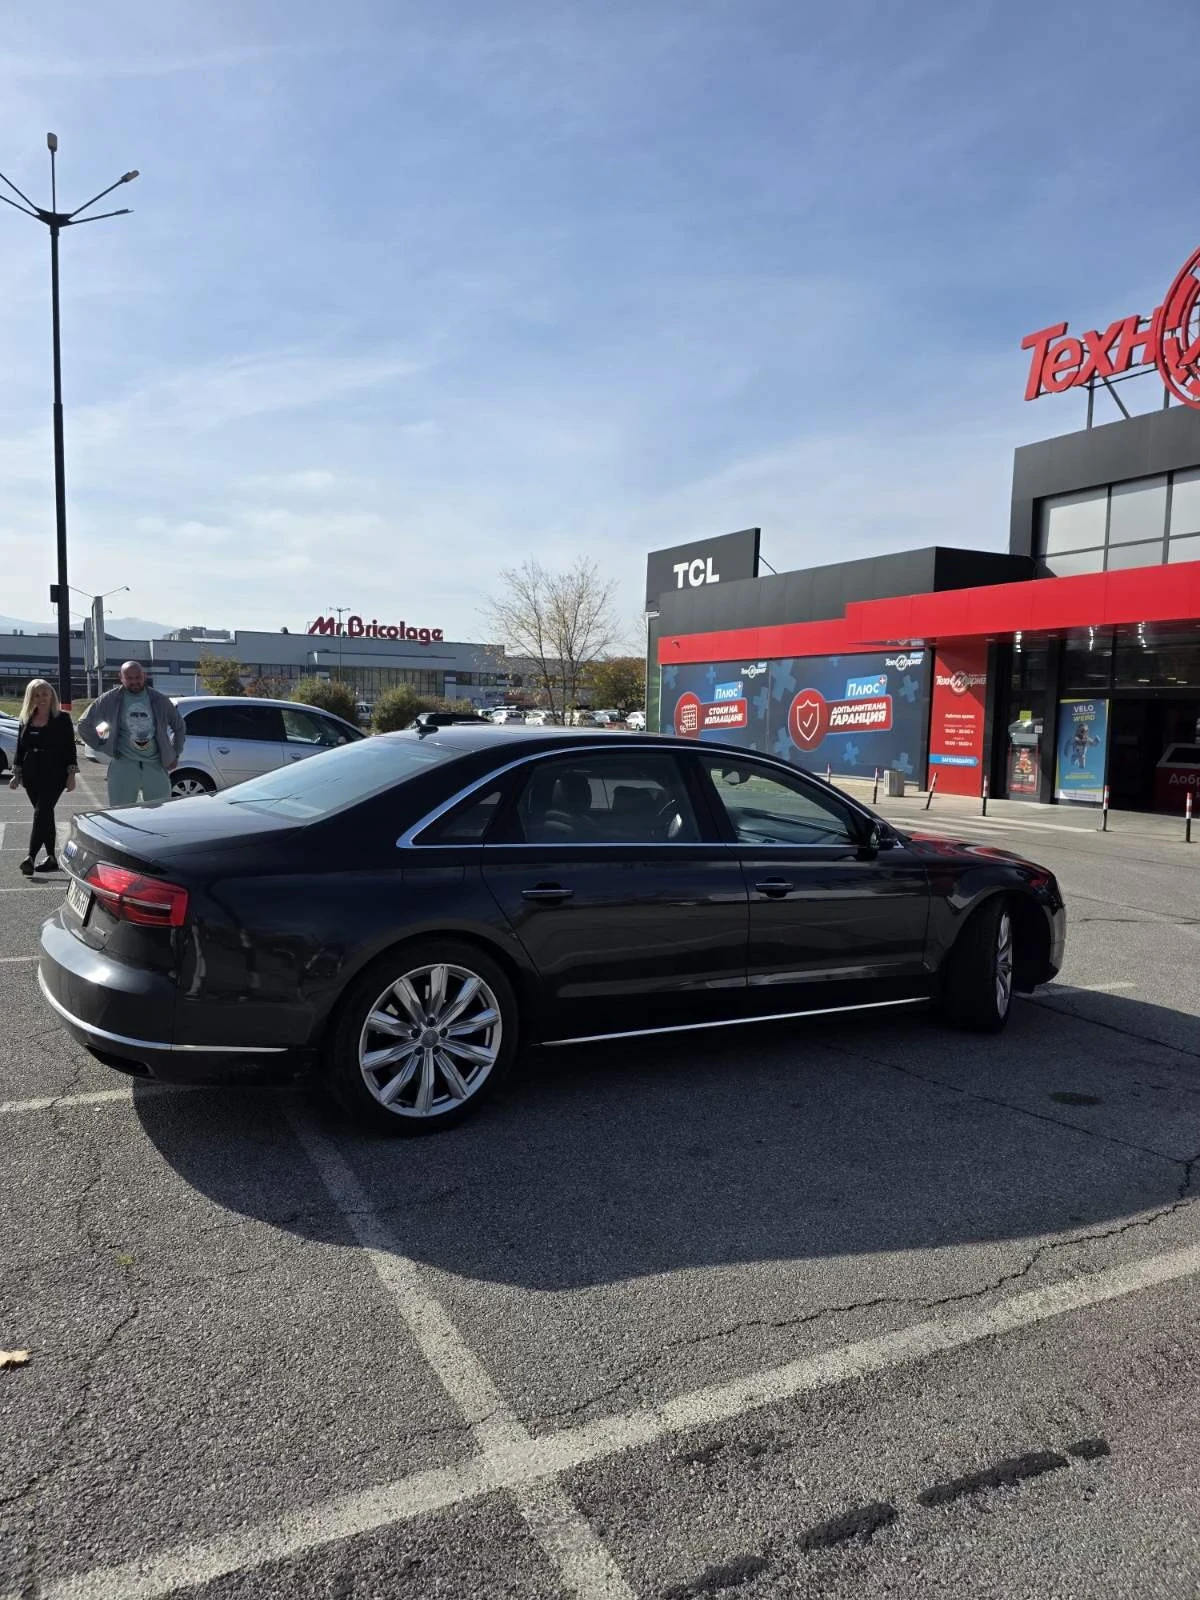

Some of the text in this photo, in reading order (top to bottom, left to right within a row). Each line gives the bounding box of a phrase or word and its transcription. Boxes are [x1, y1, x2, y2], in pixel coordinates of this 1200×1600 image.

[673, 557, 720, 589] TCL
[708, 704, 738, 716] СТОКИ НА
[831, 701, 887, 715] ДОПЪЛНИТЕЛНА
[1073, 704, 1094, 713] VELO
[704, 712, 744, 725] ИЗПЛАЩАНЕ
[829, 710, 887, 726] ГАРАНЦИЯ
